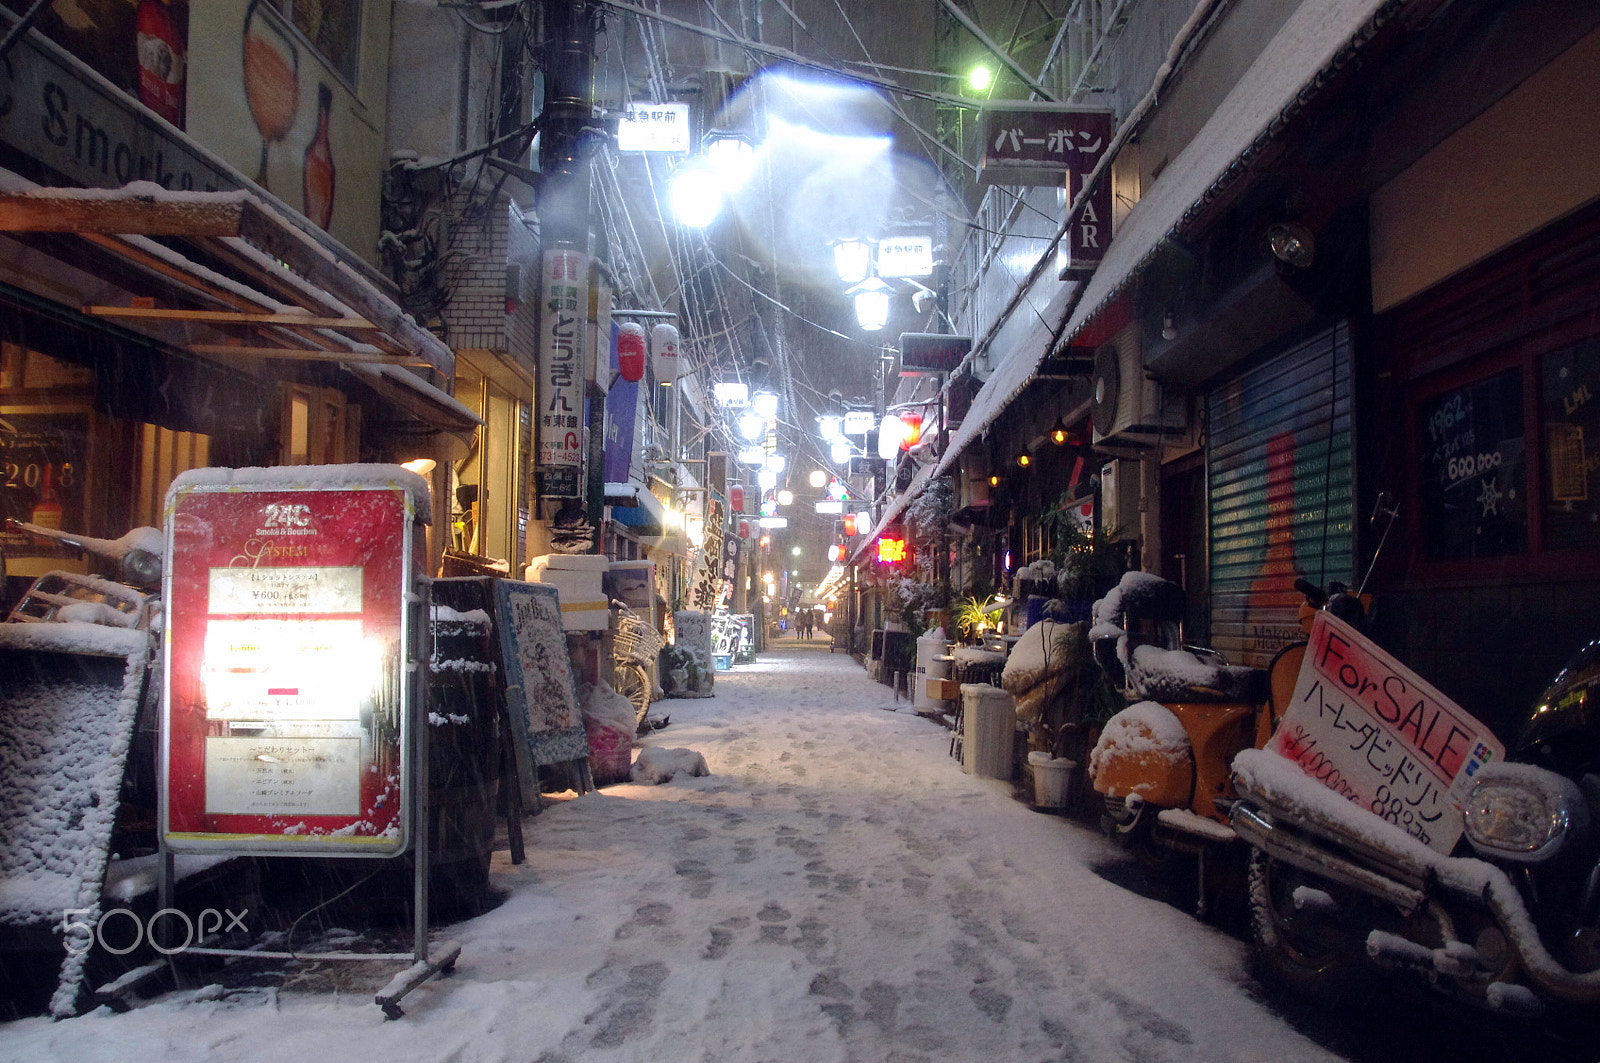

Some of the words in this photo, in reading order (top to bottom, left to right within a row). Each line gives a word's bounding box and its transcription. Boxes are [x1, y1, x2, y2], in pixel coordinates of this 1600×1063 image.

[625, 110, 676, 123] 東急駅前
[995, 128, 1102, 153] バーボン
[549, 314, 574, 412] とうぎん
[256, 528, 280, 536] Smoke
[287, 528, 318, 536] Bourbon
[1321, 632, 1377, 696] For
[1374, 676, 1470, 781] SALE
